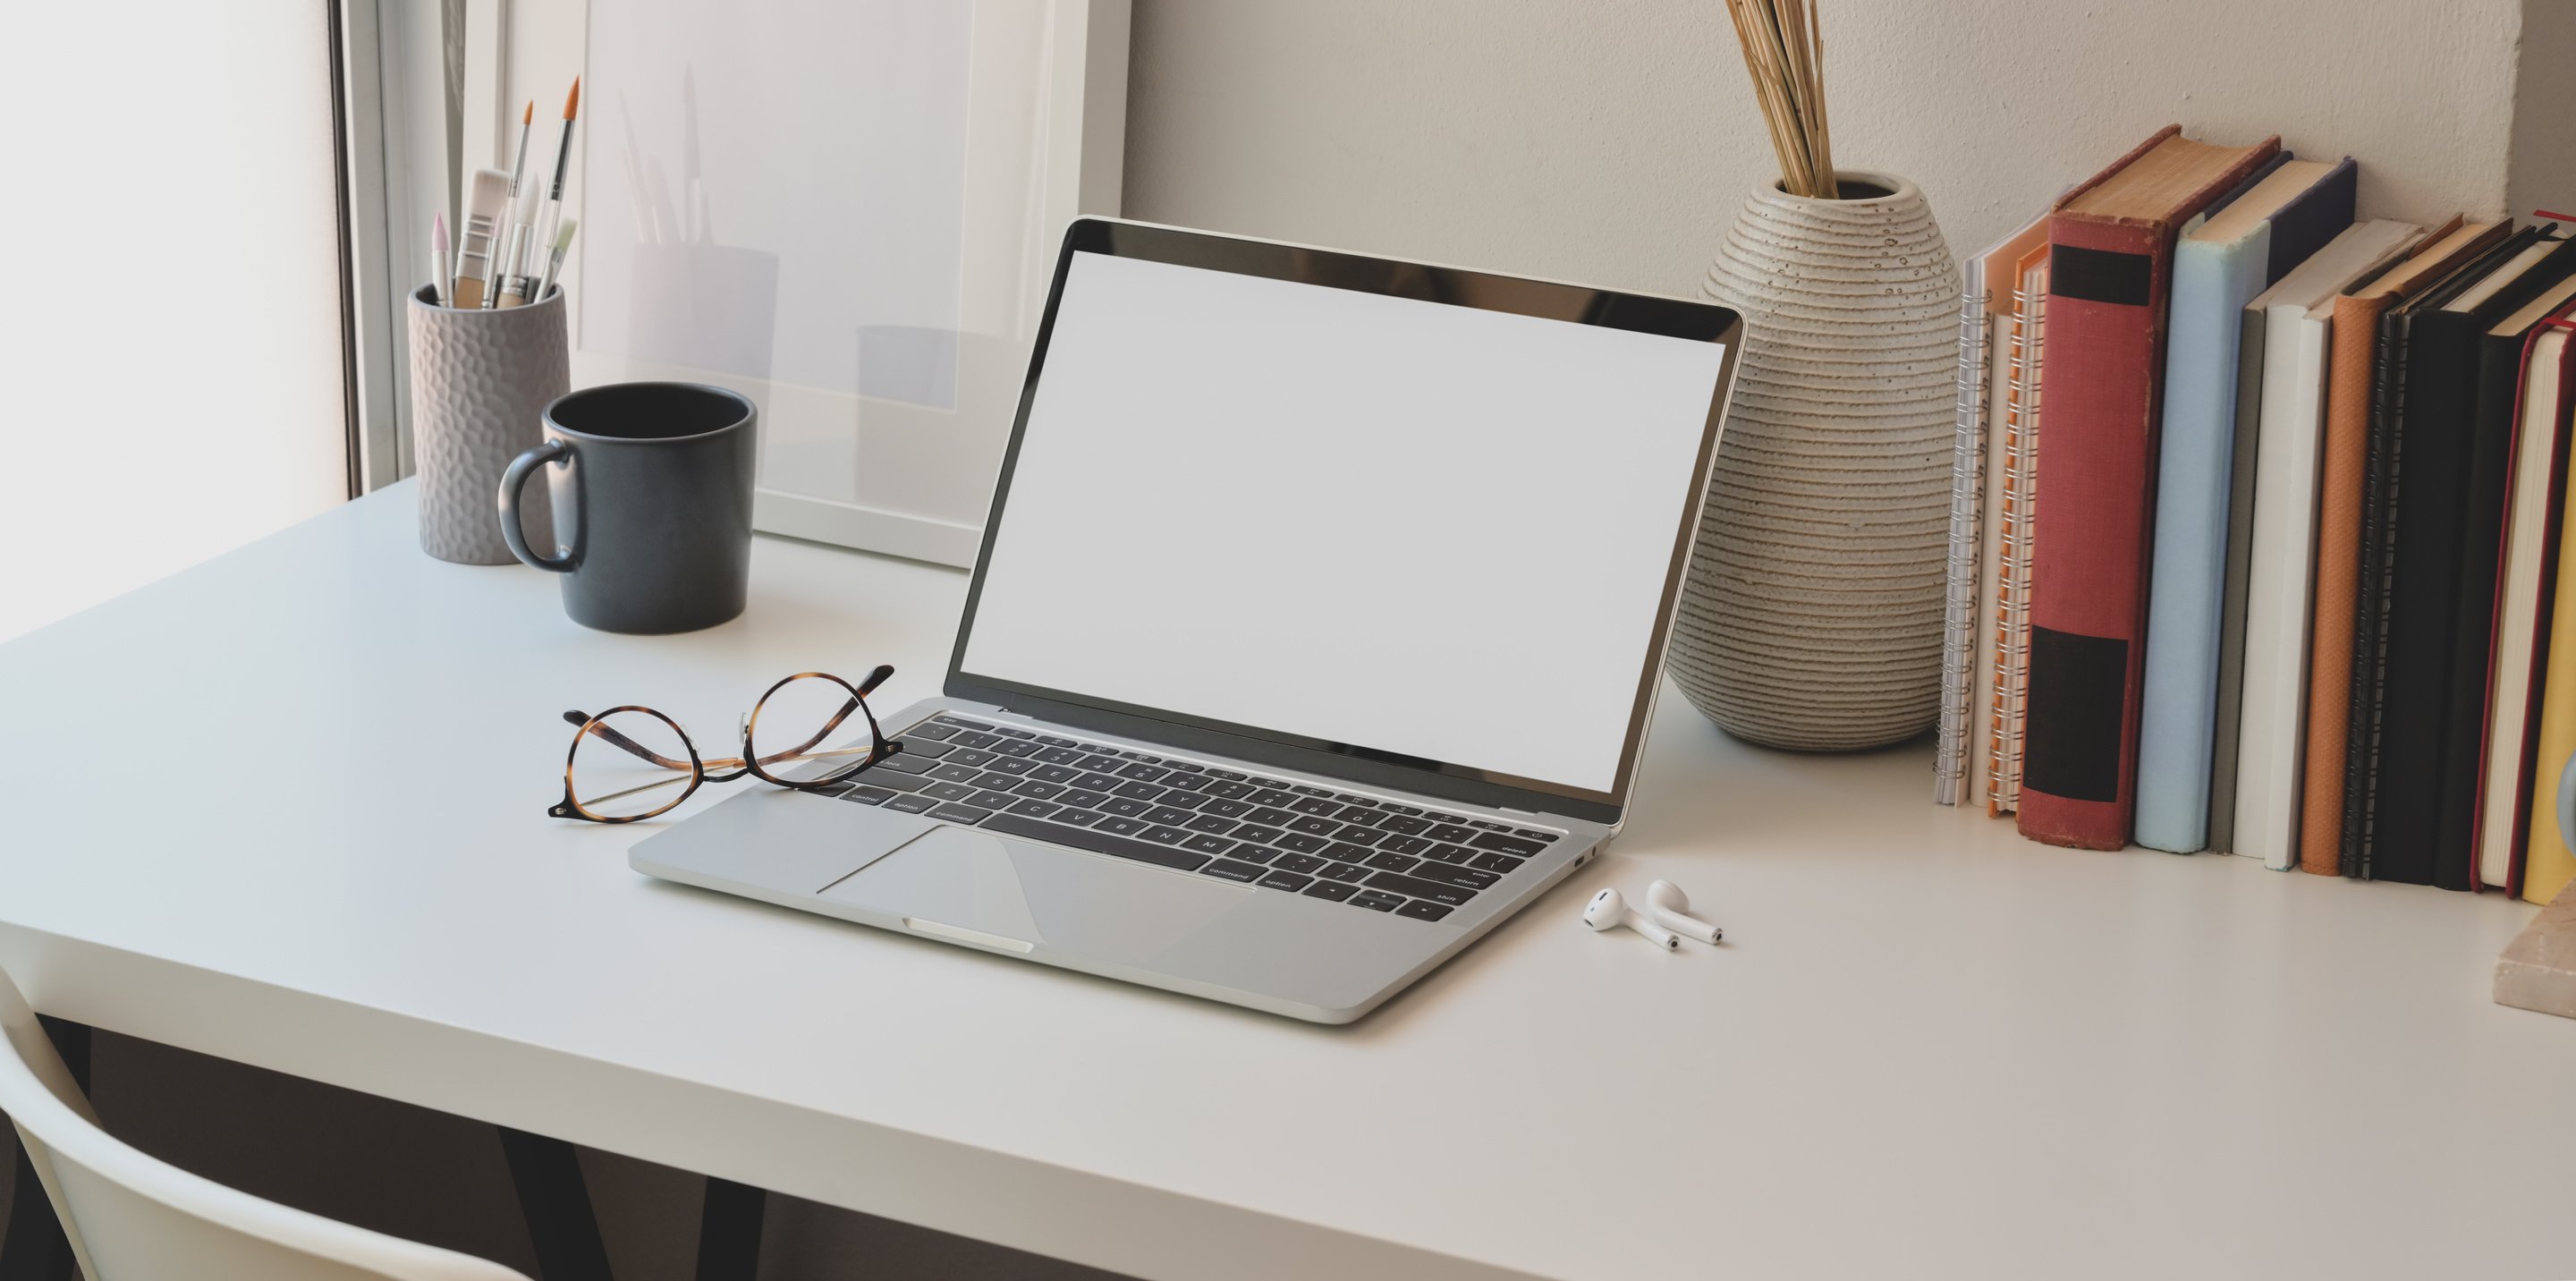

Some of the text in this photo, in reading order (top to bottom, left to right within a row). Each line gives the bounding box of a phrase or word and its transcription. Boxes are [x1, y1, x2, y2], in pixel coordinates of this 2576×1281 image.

[851, 793, 880, 802] control
[894, 802, 919, 810] option
[936, 810, 975, 821] command
[1502, 846, 1528, 854] delete
[1208, 867, 1250, 879] command
[1264, 878, 1292, 888] option
[1453, 877, 1480, 887] return
[1436, 894, 1458, 903] shift
